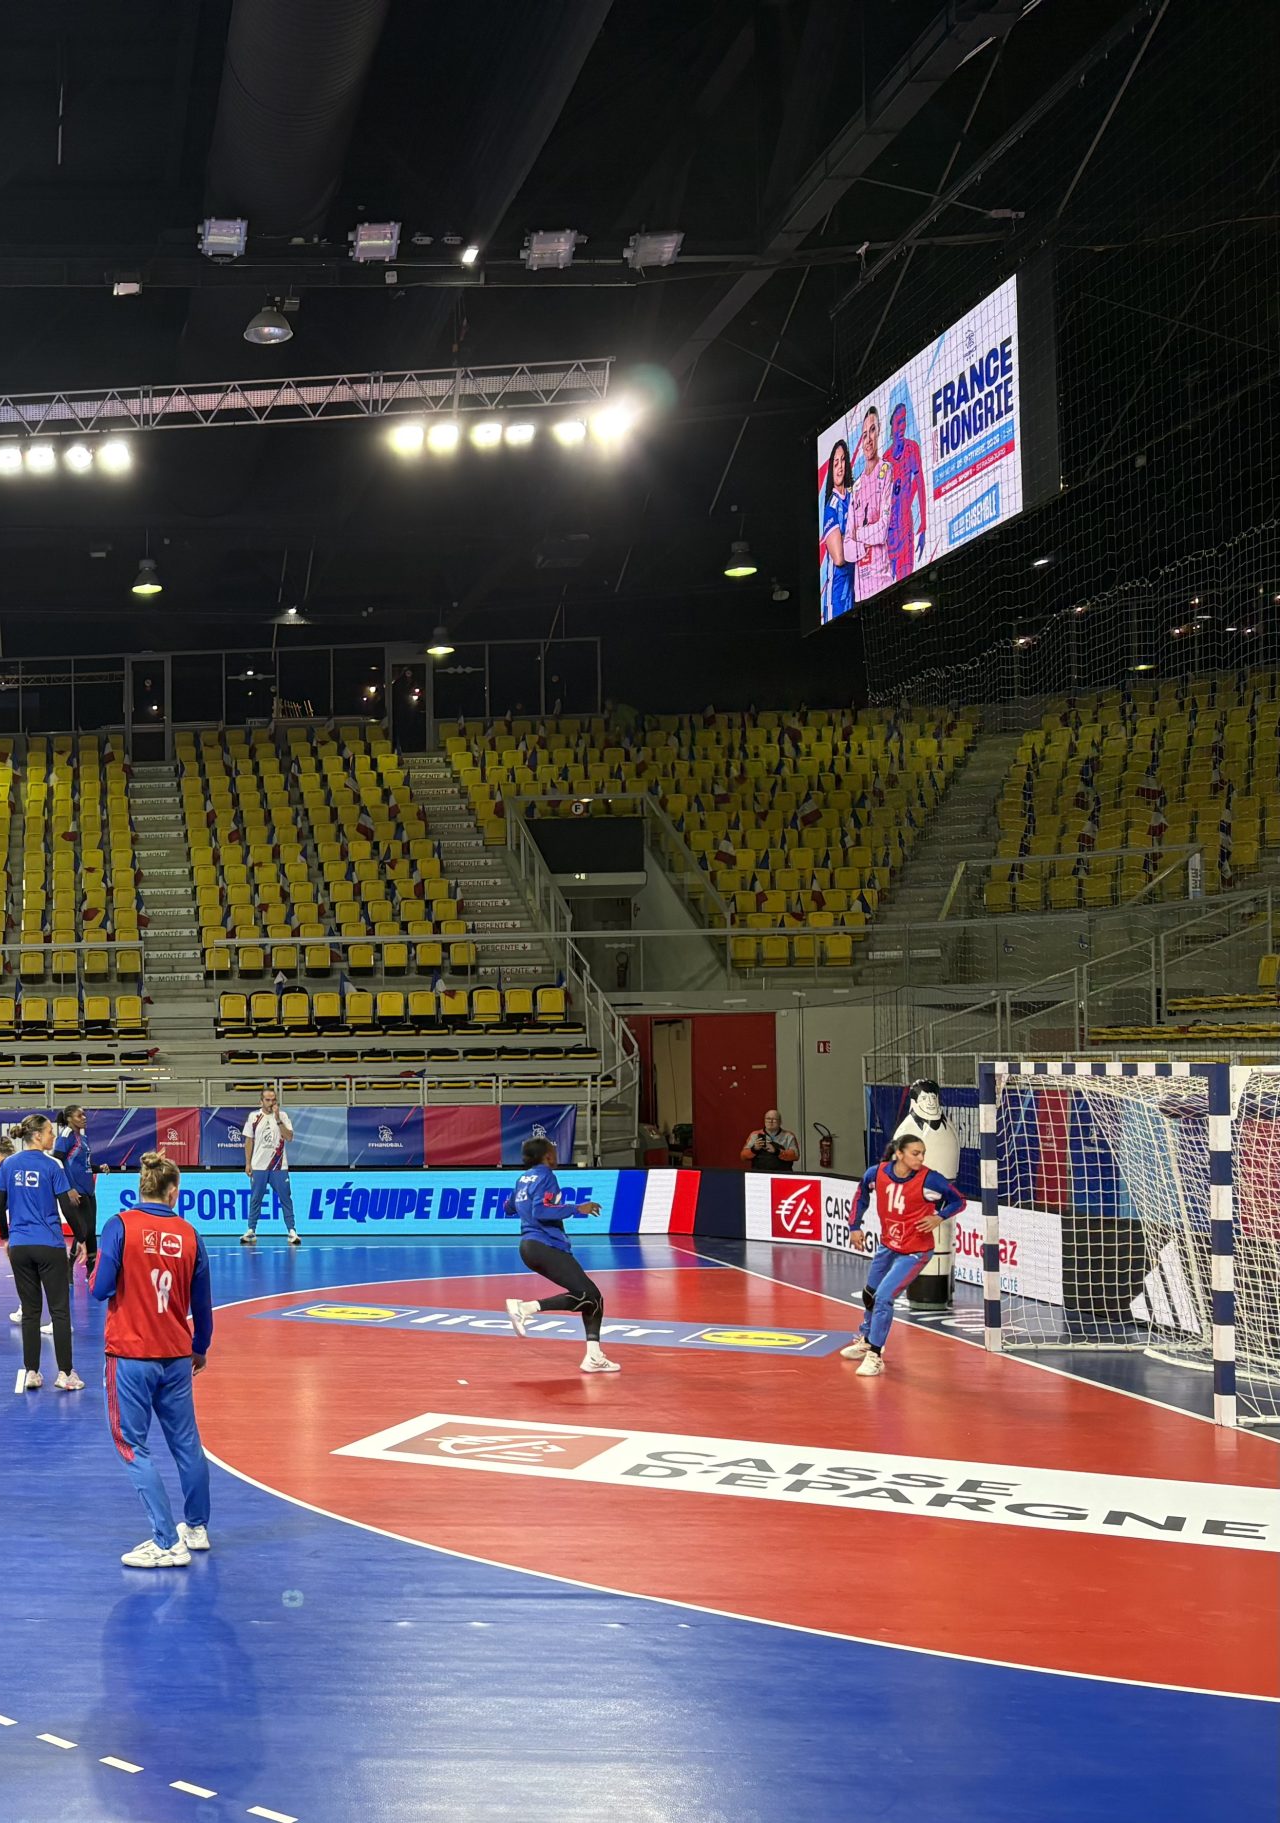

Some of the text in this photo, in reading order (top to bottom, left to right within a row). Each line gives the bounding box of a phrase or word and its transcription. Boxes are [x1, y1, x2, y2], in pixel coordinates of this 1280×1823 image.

[932, 336, 1012, 427] FRANCE
[940, 375, 1013, 459] HONGRIE
[574, 804, 581, 812] F
[308, 1181, 433, 1223] L'ÉQUIPE
[438, 1187, 476, 1219] DE
[885, 1184, 906, 1214] 14
[646, 1450, 1022, 1497] CAISSE
[620, 1463, 1270, 1540] D'EPARGNE
